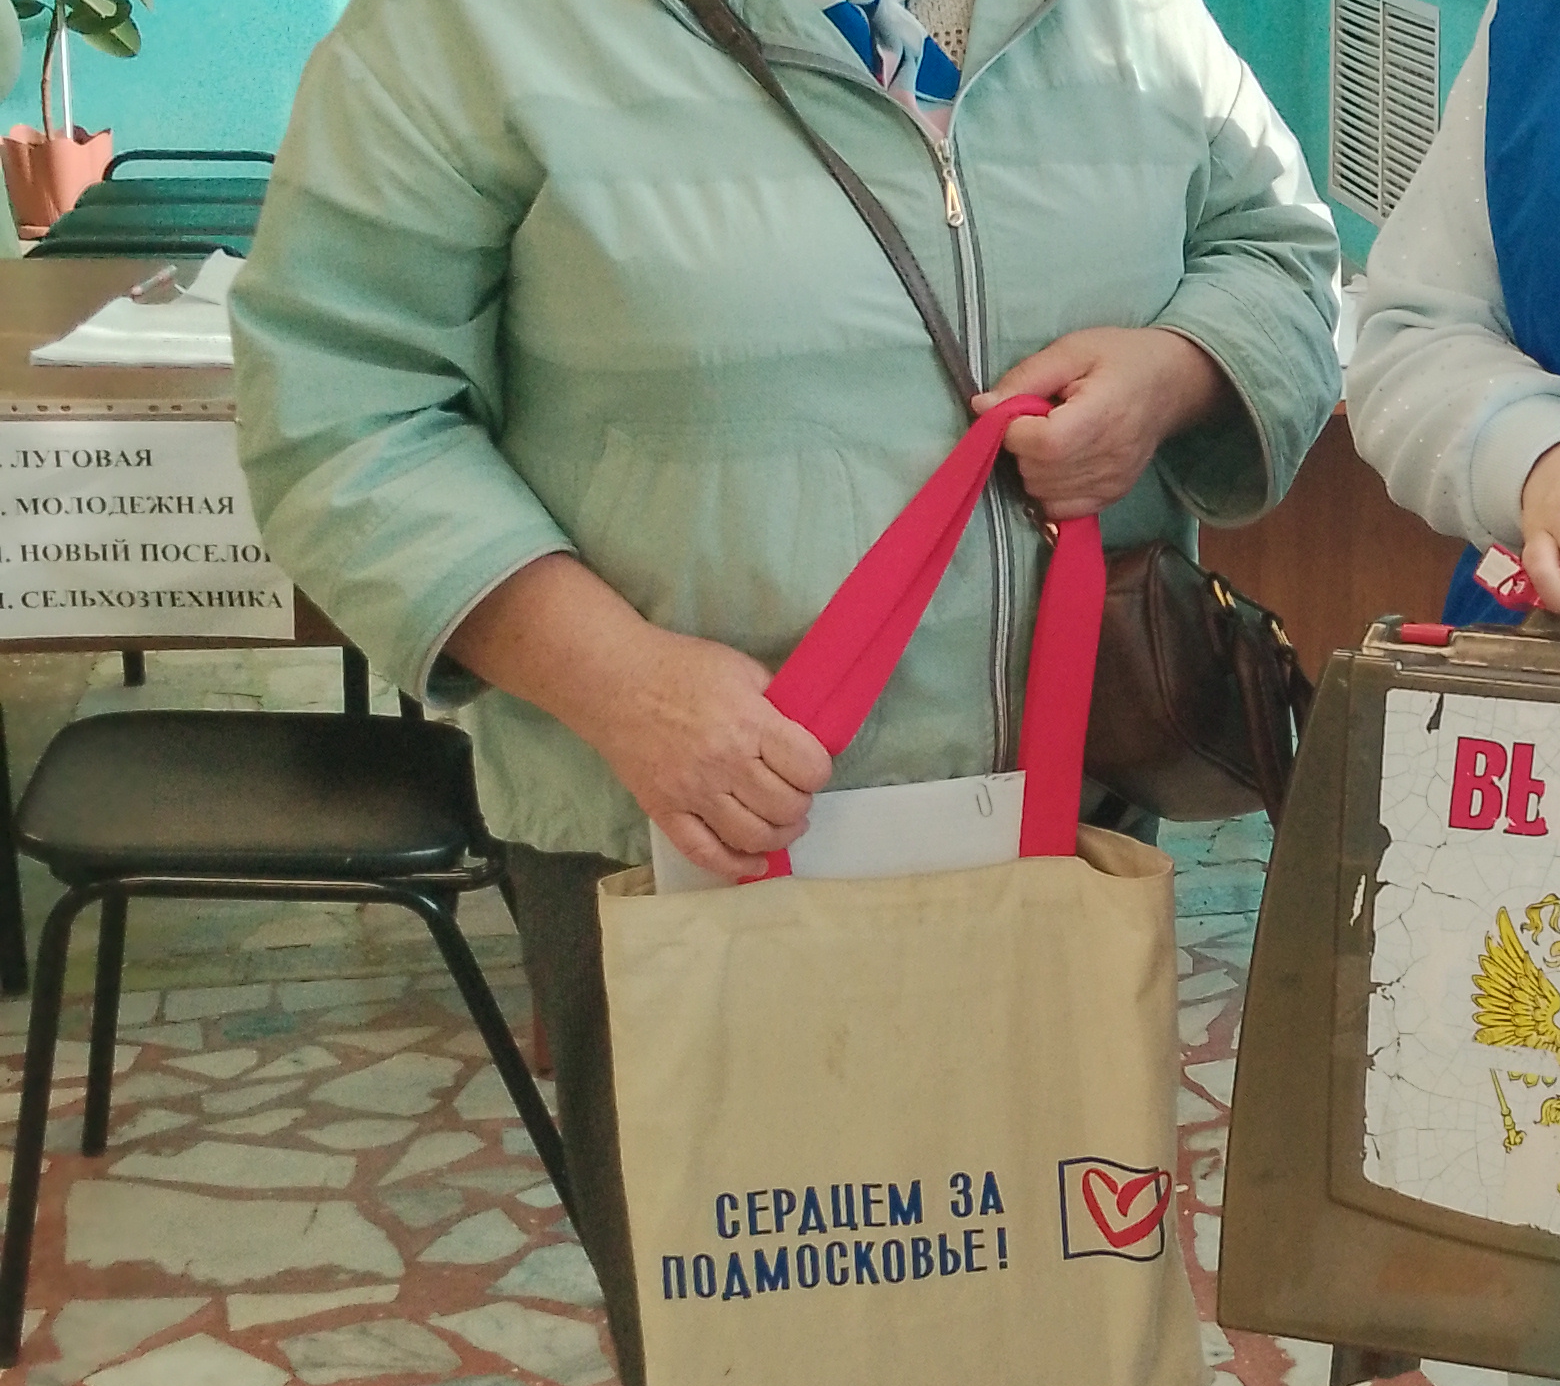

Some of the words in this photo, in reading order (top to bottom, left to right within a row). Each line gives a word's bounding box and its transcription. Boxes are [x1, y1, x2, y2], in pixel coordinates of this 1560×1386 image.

[11, 449, 152, 468] ЛУГОВАЯ
[16, 496, 234, 516] МОЛОДЕЖНАЯ
[21, 538, 130, 562] НОВЫЙ
[21, 589, 283, 609] СЕЛЬХОЗТЕХНИКА
[715, 1178, 924, 1240] СЕРДЦЕМ
[949, 1170, 1006, 1218] ЗА
[661, 1227, 1010, 1302] ПОДМОСКОВЬЕ!
